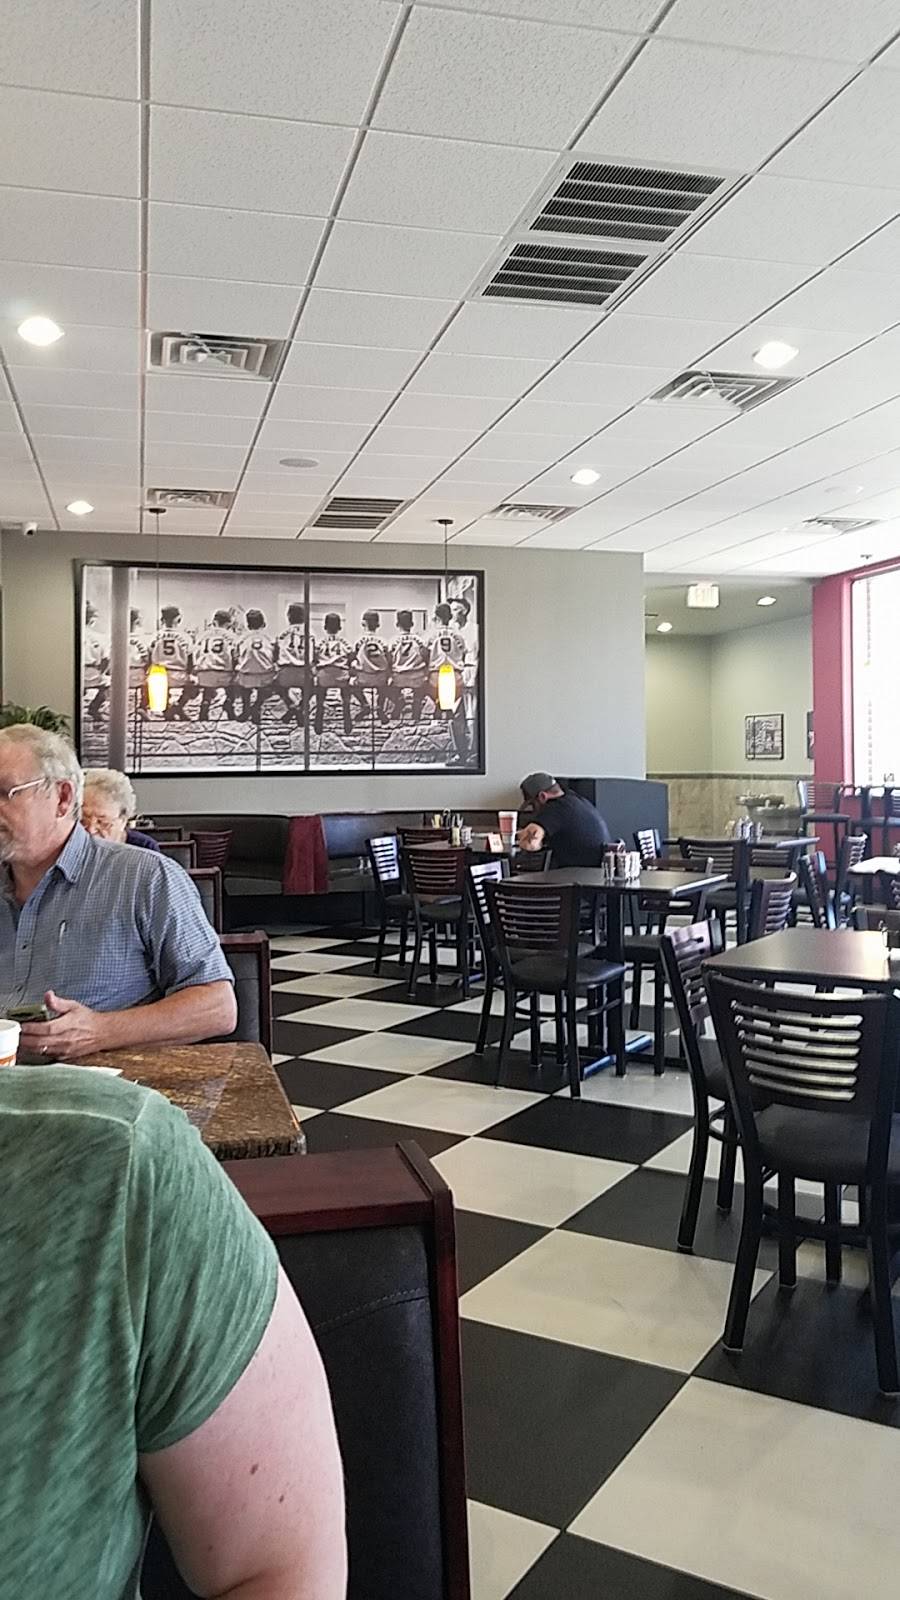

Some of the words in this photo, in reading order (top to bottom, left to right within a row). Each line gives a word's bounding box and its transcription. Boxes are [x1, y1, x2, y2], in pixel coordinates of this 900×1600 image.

[163, 639, 176, 656] 5
[203, 638, 224, 654] 13
[324, 642, 341, 656] 14
[402, 642, 413, 656] 7
[440, 638, 451, 653] 9
